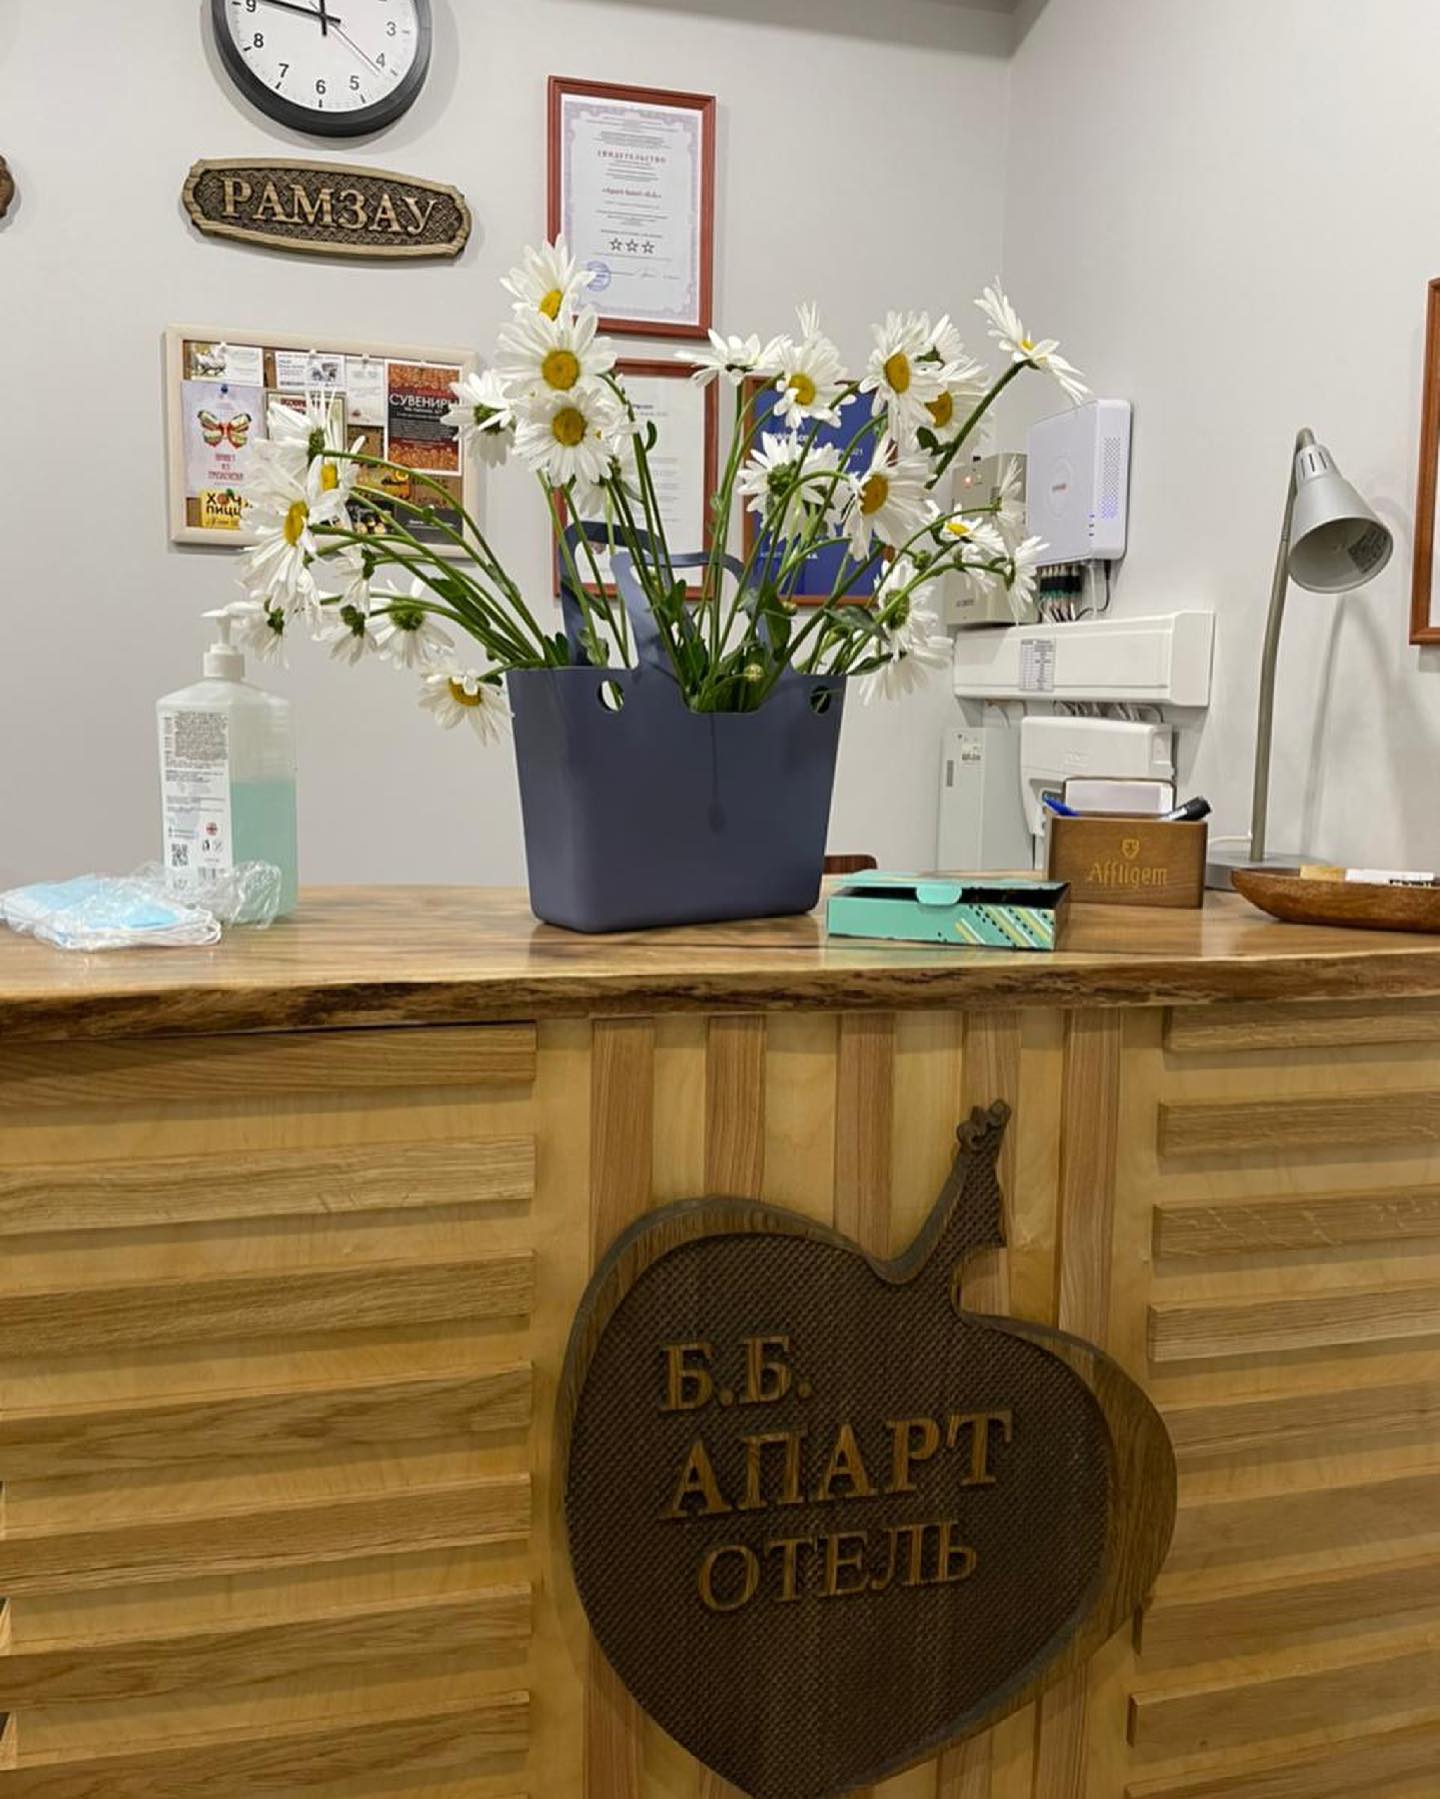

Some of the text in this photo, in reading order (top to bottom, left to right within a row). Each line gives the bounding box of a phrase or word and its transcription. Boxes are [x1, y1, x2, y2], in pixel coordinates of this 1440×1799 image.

[246, 0, 256, 12] 9
[386, 22, 397, 36] 3
[253, 33, 264, 48] 8
[376, 53, 386, 67] 4
[278, 63, 289, 78] 7
[315, 79, 326, 95] 6
[349, 75, 360, 90] 5
[221, 177, 438, 235] РАМЗАУ
[1088, 859, 1168, 889] Affligem
[659, 1336, 812, 1411] Б.Б.
[659, 1409, 1013, 1519] АПАРТ
[699, 1519, 978, 1613] ОТЕЛЬ
